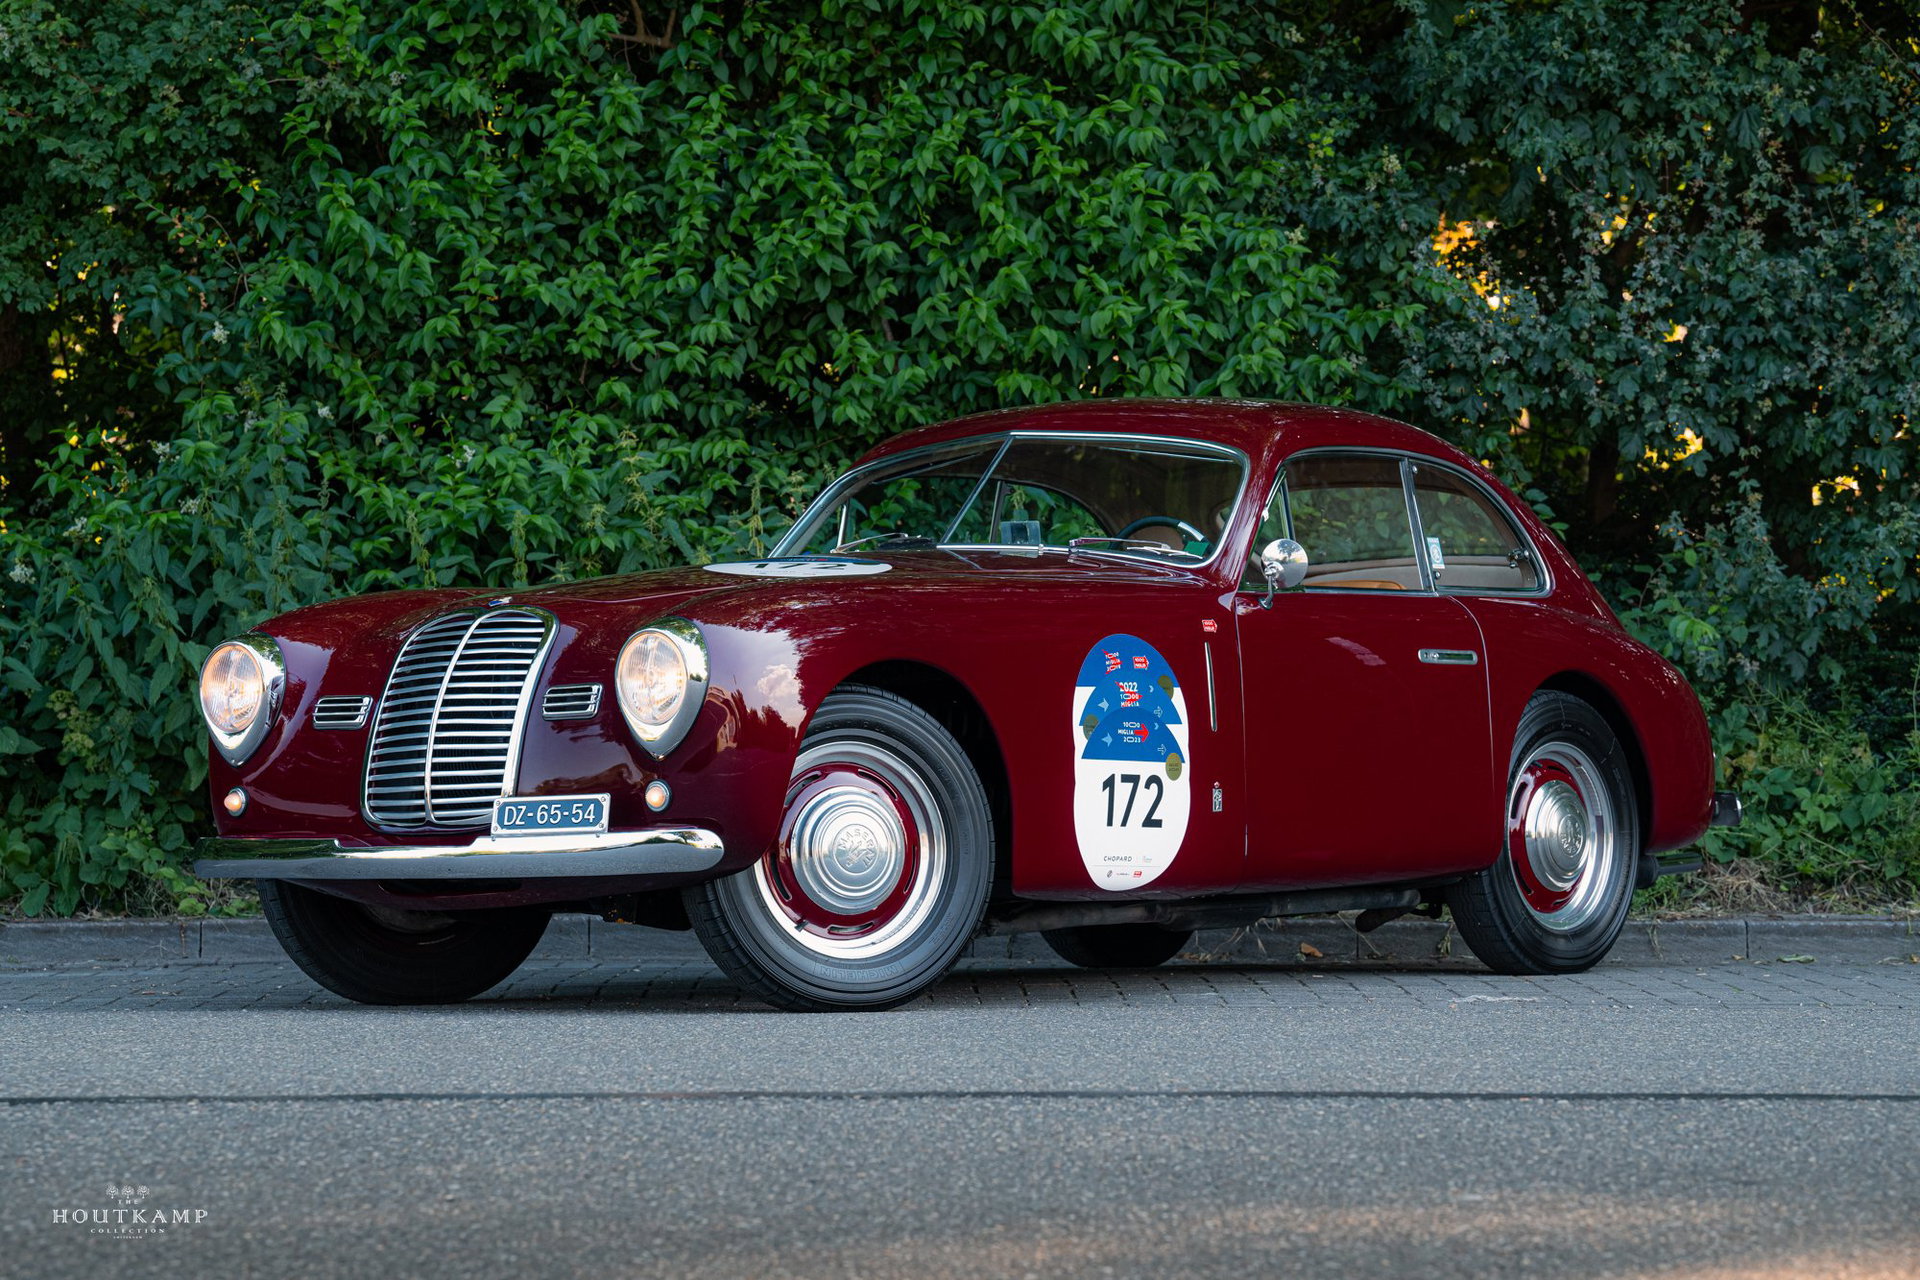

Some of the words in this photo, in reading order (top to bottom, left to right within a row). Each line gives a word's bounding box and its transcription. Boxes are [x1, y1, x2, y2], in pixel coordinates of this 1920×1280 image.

[1119, 682, 1138, 692] 2022
[1102, 773, 1163, 828] 172
[503, 803, 596, 826] DZ-65-54
[820, 964, 899, 980] MICHELIN
